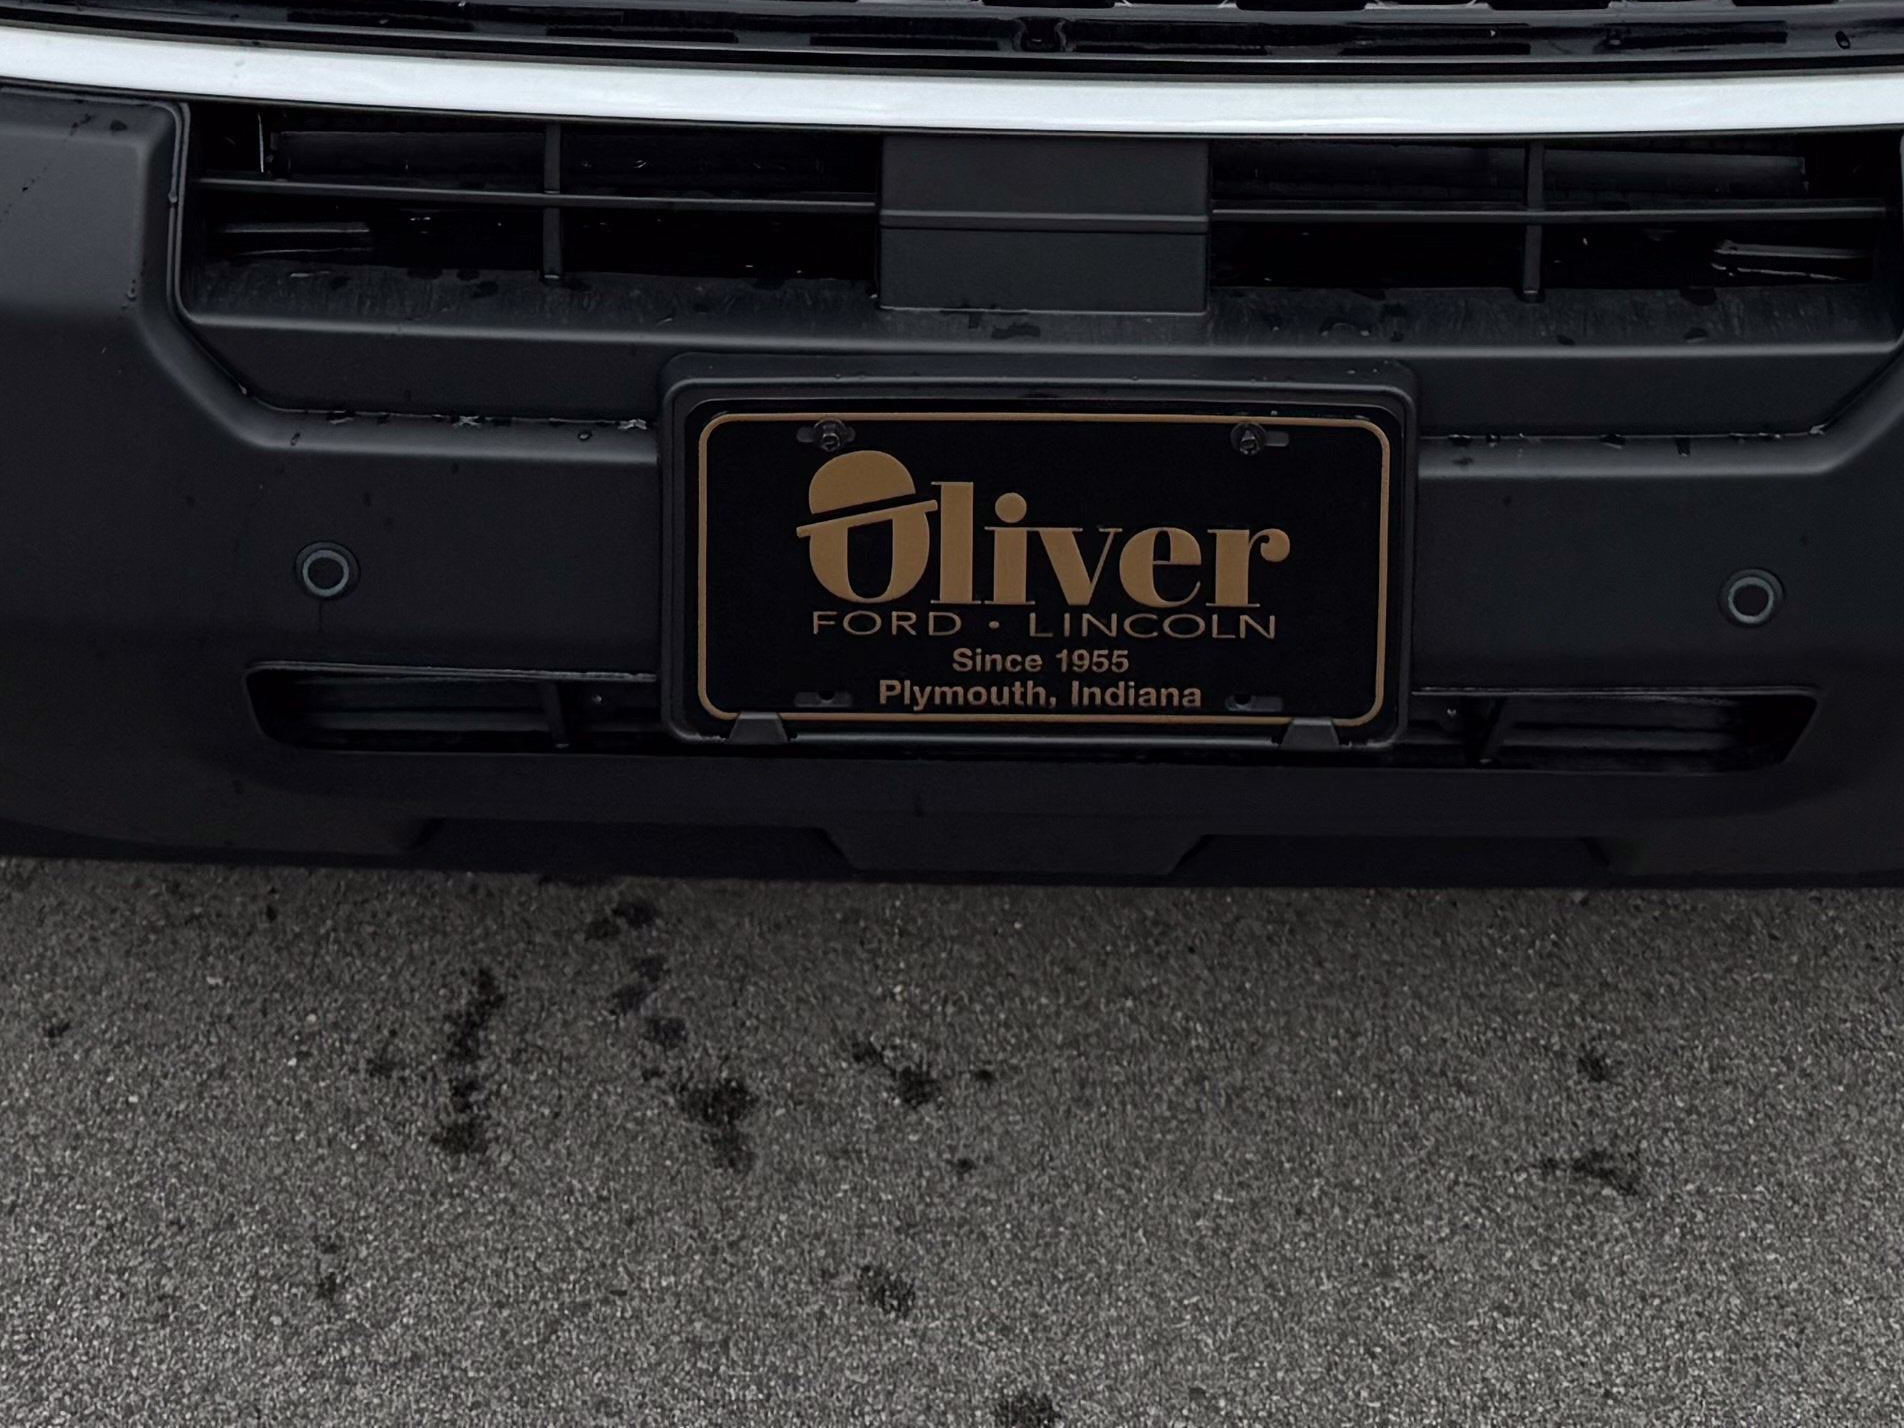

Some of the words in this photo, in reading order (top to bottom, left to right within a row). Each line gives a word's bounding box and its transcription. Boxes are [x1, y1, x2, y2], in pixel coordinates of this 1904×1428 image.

[797, 450, 1291, 609] Oliver
[812, 611, 963, 637] FORD
[1028, 612, 1277, 640] LINCOLN
[952, 648, 1044, 673] Since
[1055, 649, 1130, 673] 1955
[879, 679, 1058, 711] Plymouth,
[1071, 680, 1202, 708] Indiana
